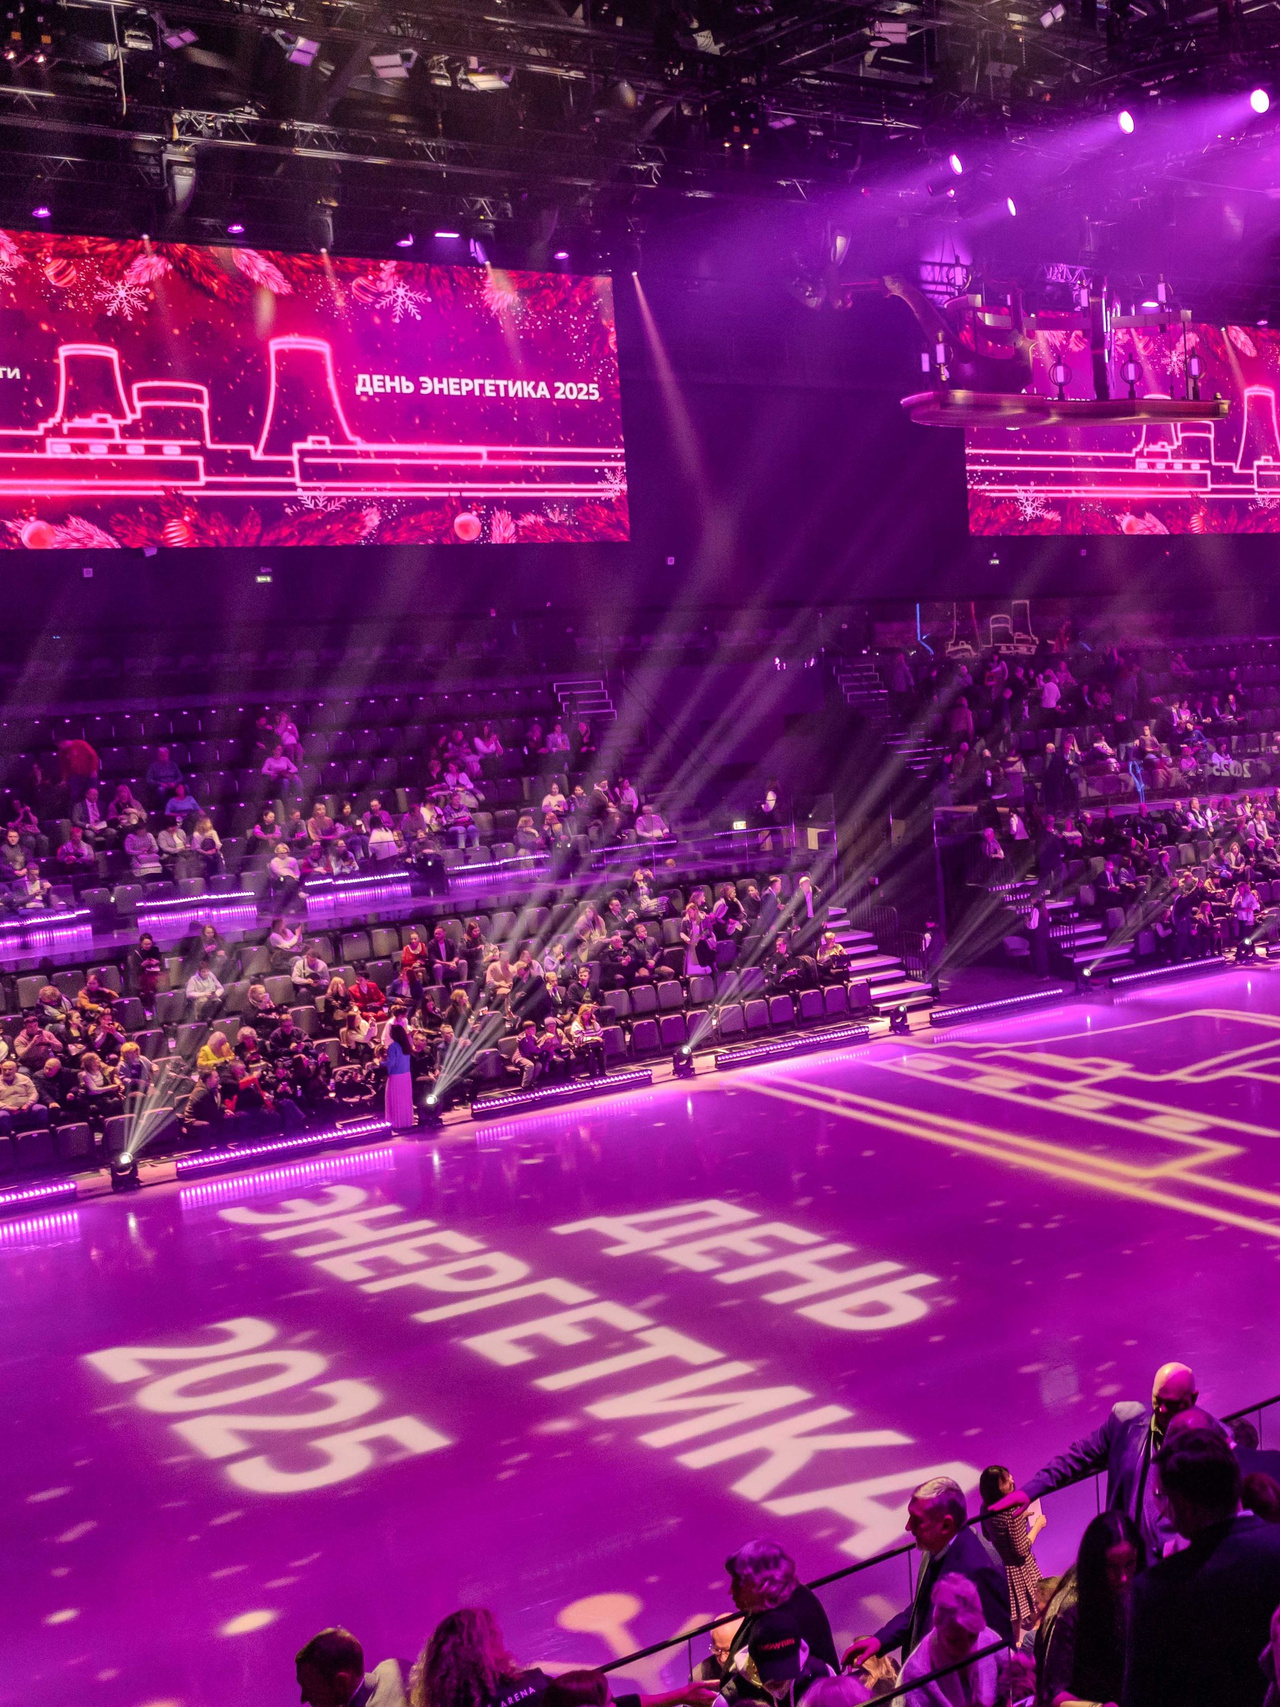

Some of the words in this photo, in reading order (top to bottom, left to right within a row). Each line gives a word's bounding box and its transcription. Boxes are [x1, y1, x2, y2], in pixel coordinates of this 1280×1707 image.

[355, 373, 415, 396] ДЕНЬ
[418, 376, 551, 399] ЭНЕРГЕТИКА
[553, 381, 600, 401] 2025
[549, 1199, 942, 1331] ДЕНЬ
[80, 1316, 455, 1494] 2025
[217, 1184, 984, 1561] ЭНЕРГЕТИКА
[501, 1686, 536, 1707] ARENA
